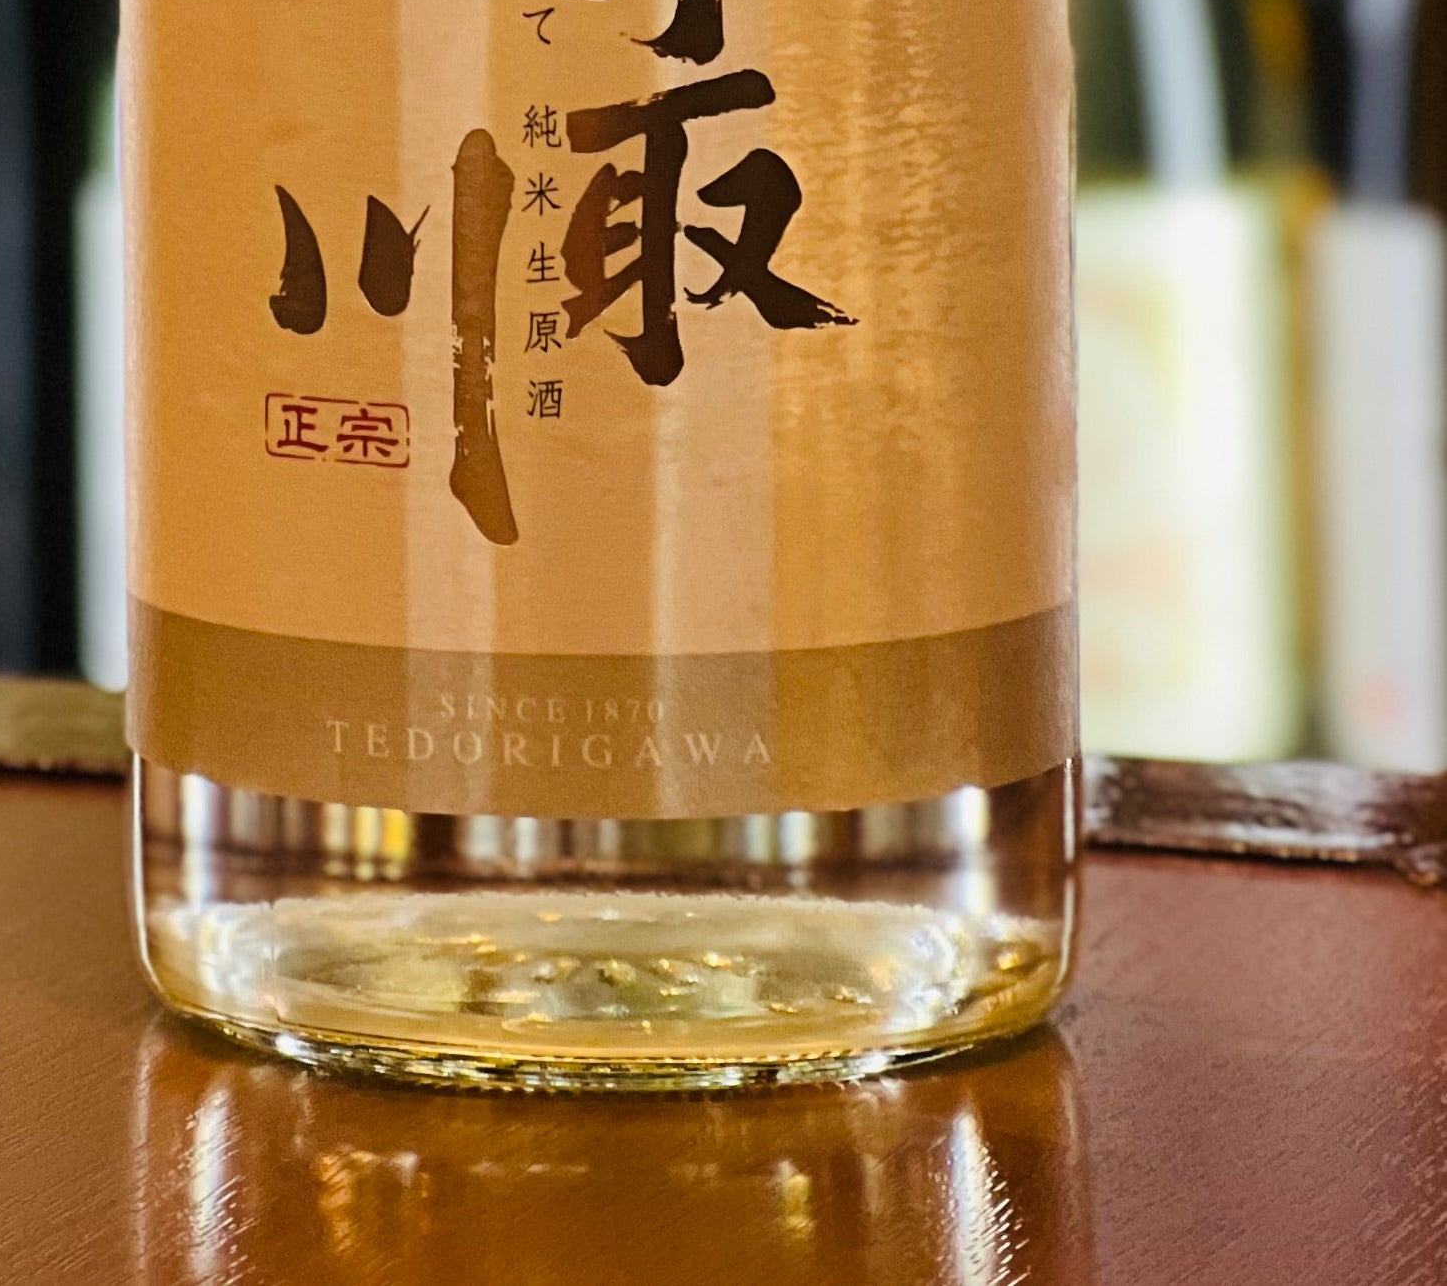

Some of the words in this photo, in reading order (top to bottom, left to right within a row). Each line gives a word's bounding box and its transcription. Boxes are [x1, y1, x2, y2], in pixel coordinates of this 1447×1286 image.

[521, 104, 564, 420] 純米生原酒
[276, 403, 399, 458] 正宗
[439, 692, 566, 724] SINCE
[585, 697, 665, 724] 1870
[326, 719, 773, 767] TEDORIGAWA
